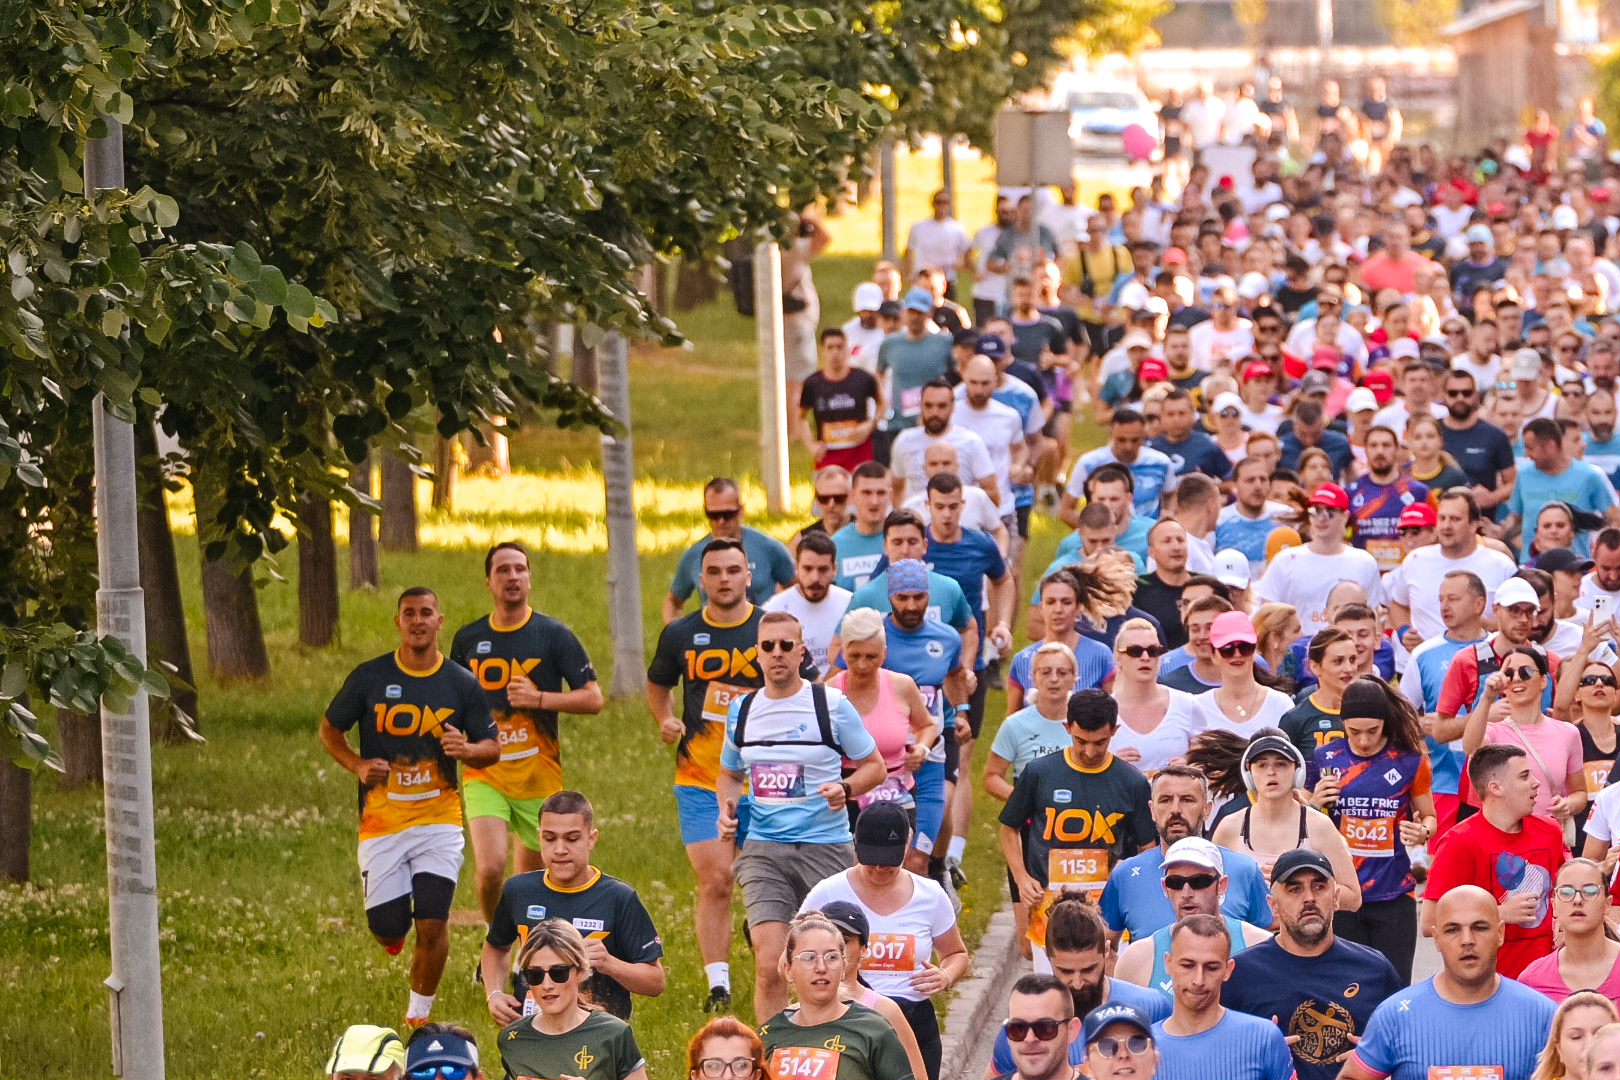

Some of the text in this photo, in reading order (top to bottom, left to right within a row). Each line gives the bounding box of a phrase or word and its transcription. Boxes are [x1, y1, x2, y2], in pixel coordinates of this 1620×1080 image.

[684, 648, 760, 681] 10K
[374, 702, 456, 740] 10K
[396, 770, 431, 786] 1344
[757, 773, 797, 790] 2207
[1348, 797, 1400, 810] BEZ FRKE
[1043, 807, 1124, 844] 10K
[1346, 825, 1388, 842] 5042
[1060, 859, 1098, 875] 1153
[580, 921, 597, 929] 1232
[863, 942, 905, 959] 5017
[1097, 1005, 1138, 1019] YALE
[778, 1056, 825, 1078] 5147
